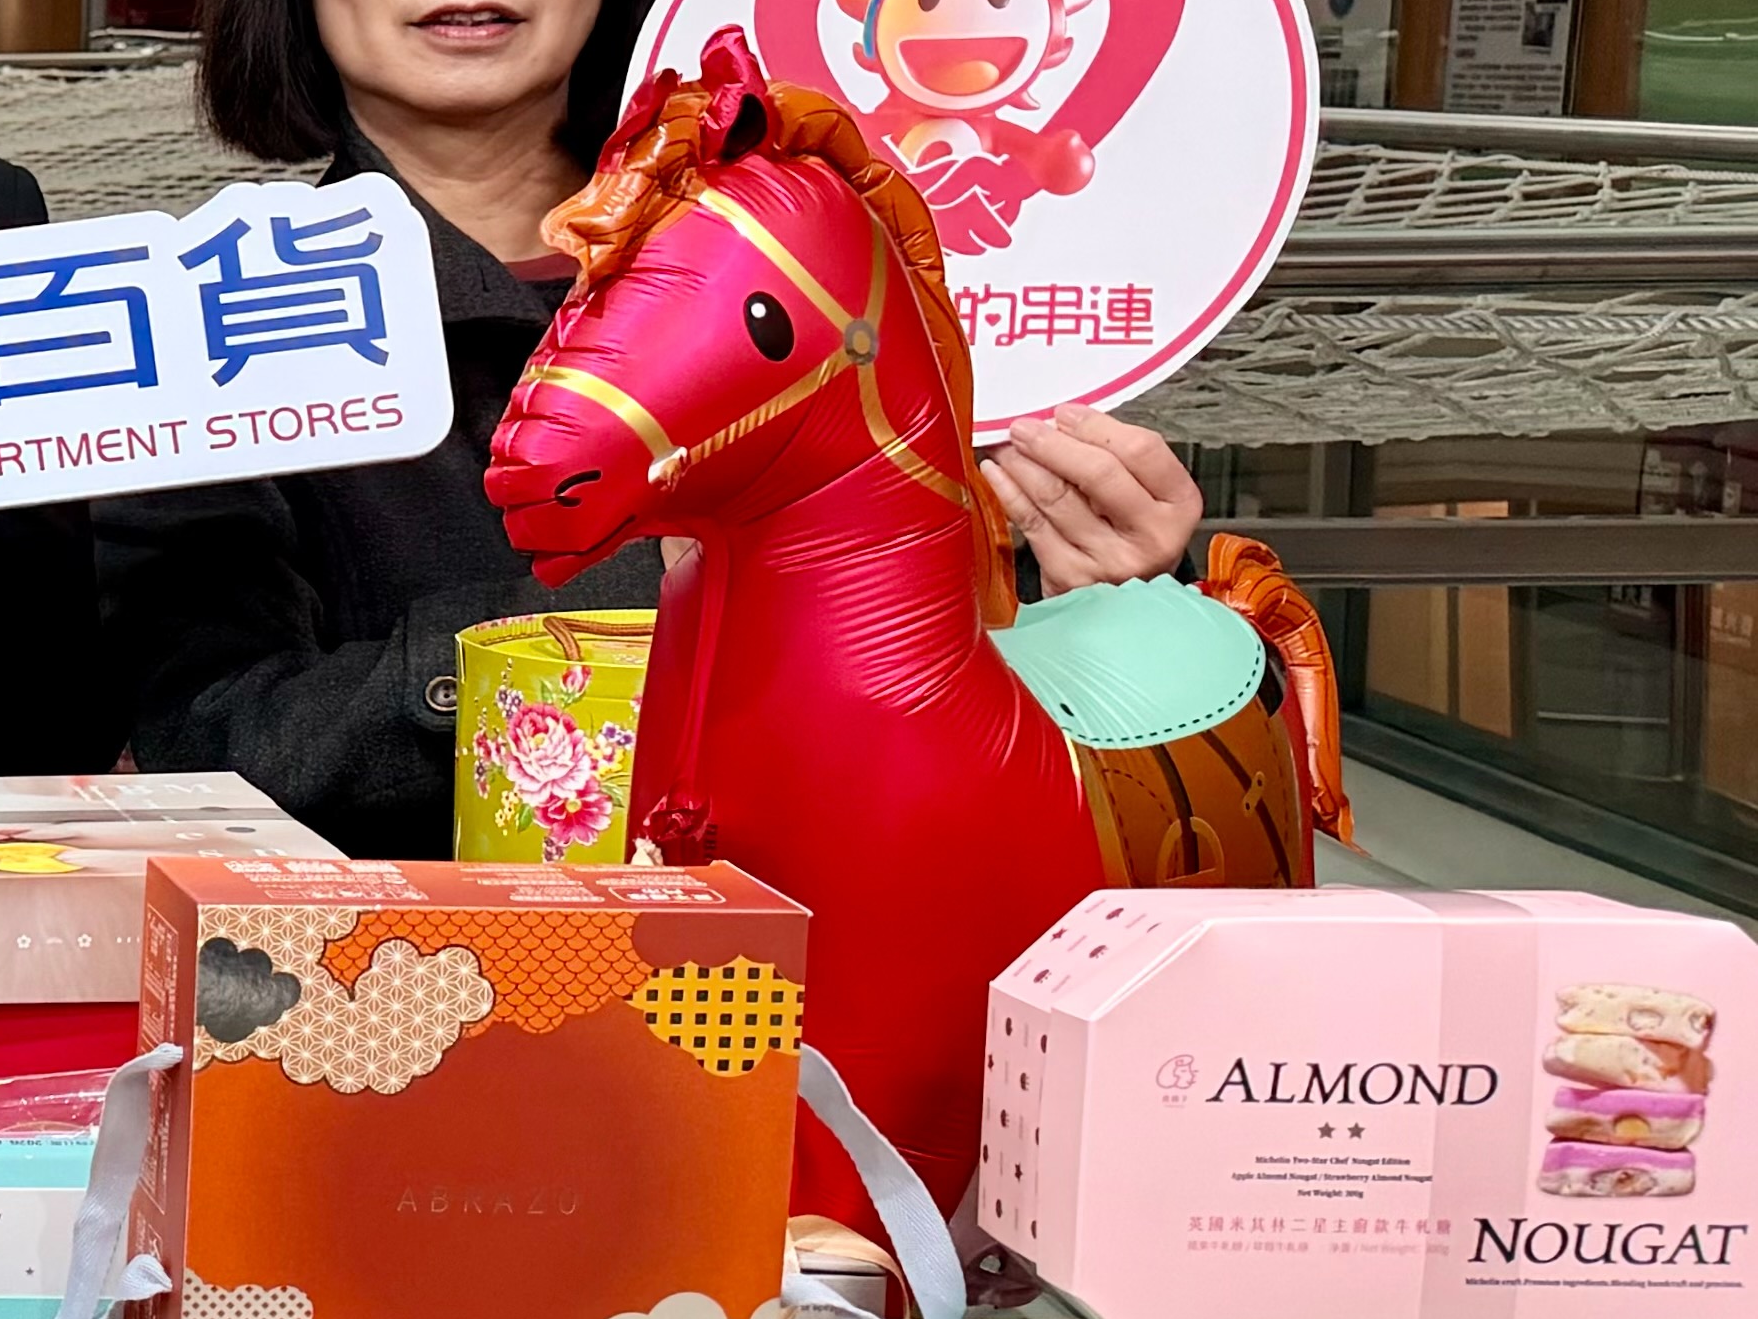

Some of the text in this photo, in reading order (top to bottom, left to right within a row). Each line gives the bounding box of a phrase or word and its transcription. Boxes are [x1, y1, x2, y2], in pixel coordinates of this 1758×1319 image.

[207, 393, 405, 451] STORES
[1204, 1056, 1500, 1107] ALMOND
[1256, 1171, 1289, 1182] Almond
[1289, 1172, 1318, 1183] Nougat
[1371, 1172, 1403, 1182] Almond
[1351, 1156, 1381, 1167] Nougat
[395, 1184, 584, 1217] ABRAZO
[1467, 1217, 1749, 1266] NOUGAT
